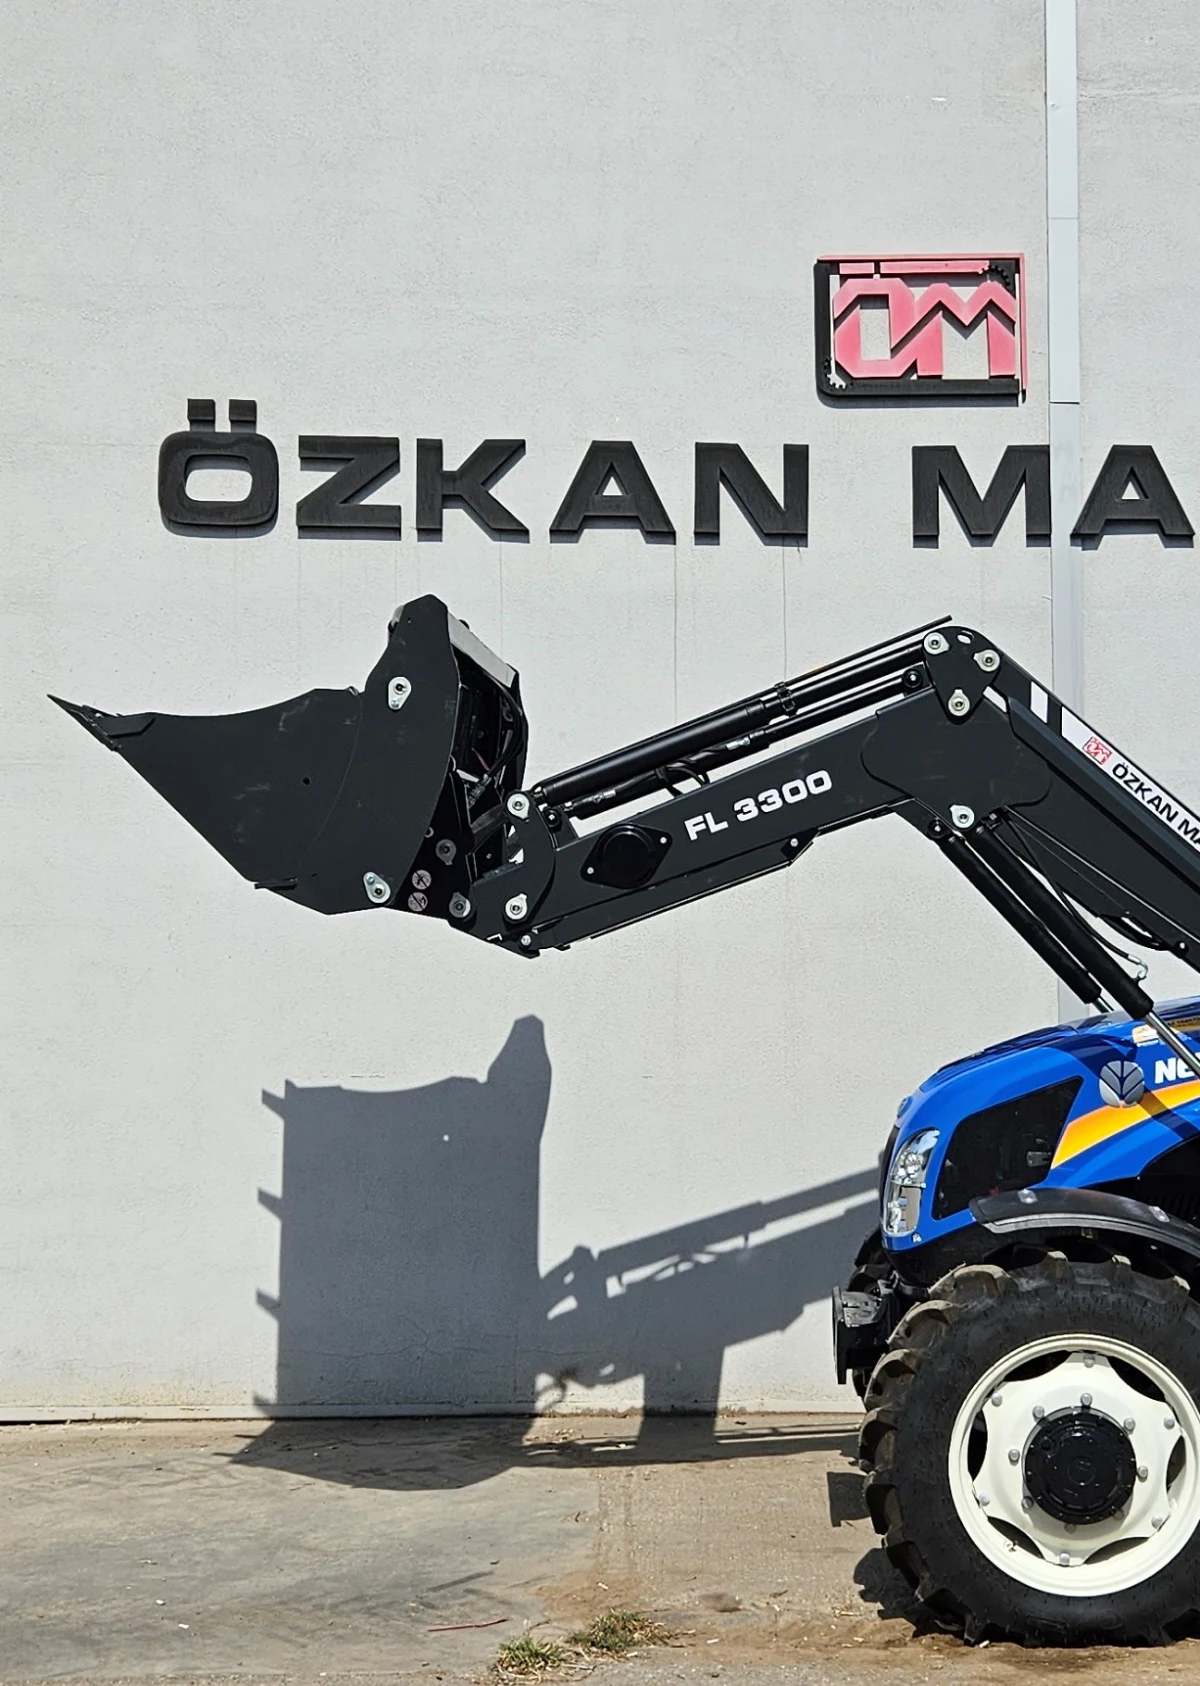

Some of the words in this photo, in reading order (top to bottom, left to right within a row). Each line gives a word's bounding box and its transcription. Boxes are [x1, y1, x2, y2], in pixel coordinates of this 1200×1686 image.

[158, 398, 809, 541] ÖZKAN
[684, 811, 729, 841] FL
[733, 769, 833, 822] 3300
[1111, 762, 1179, 824] ÖZKAN
